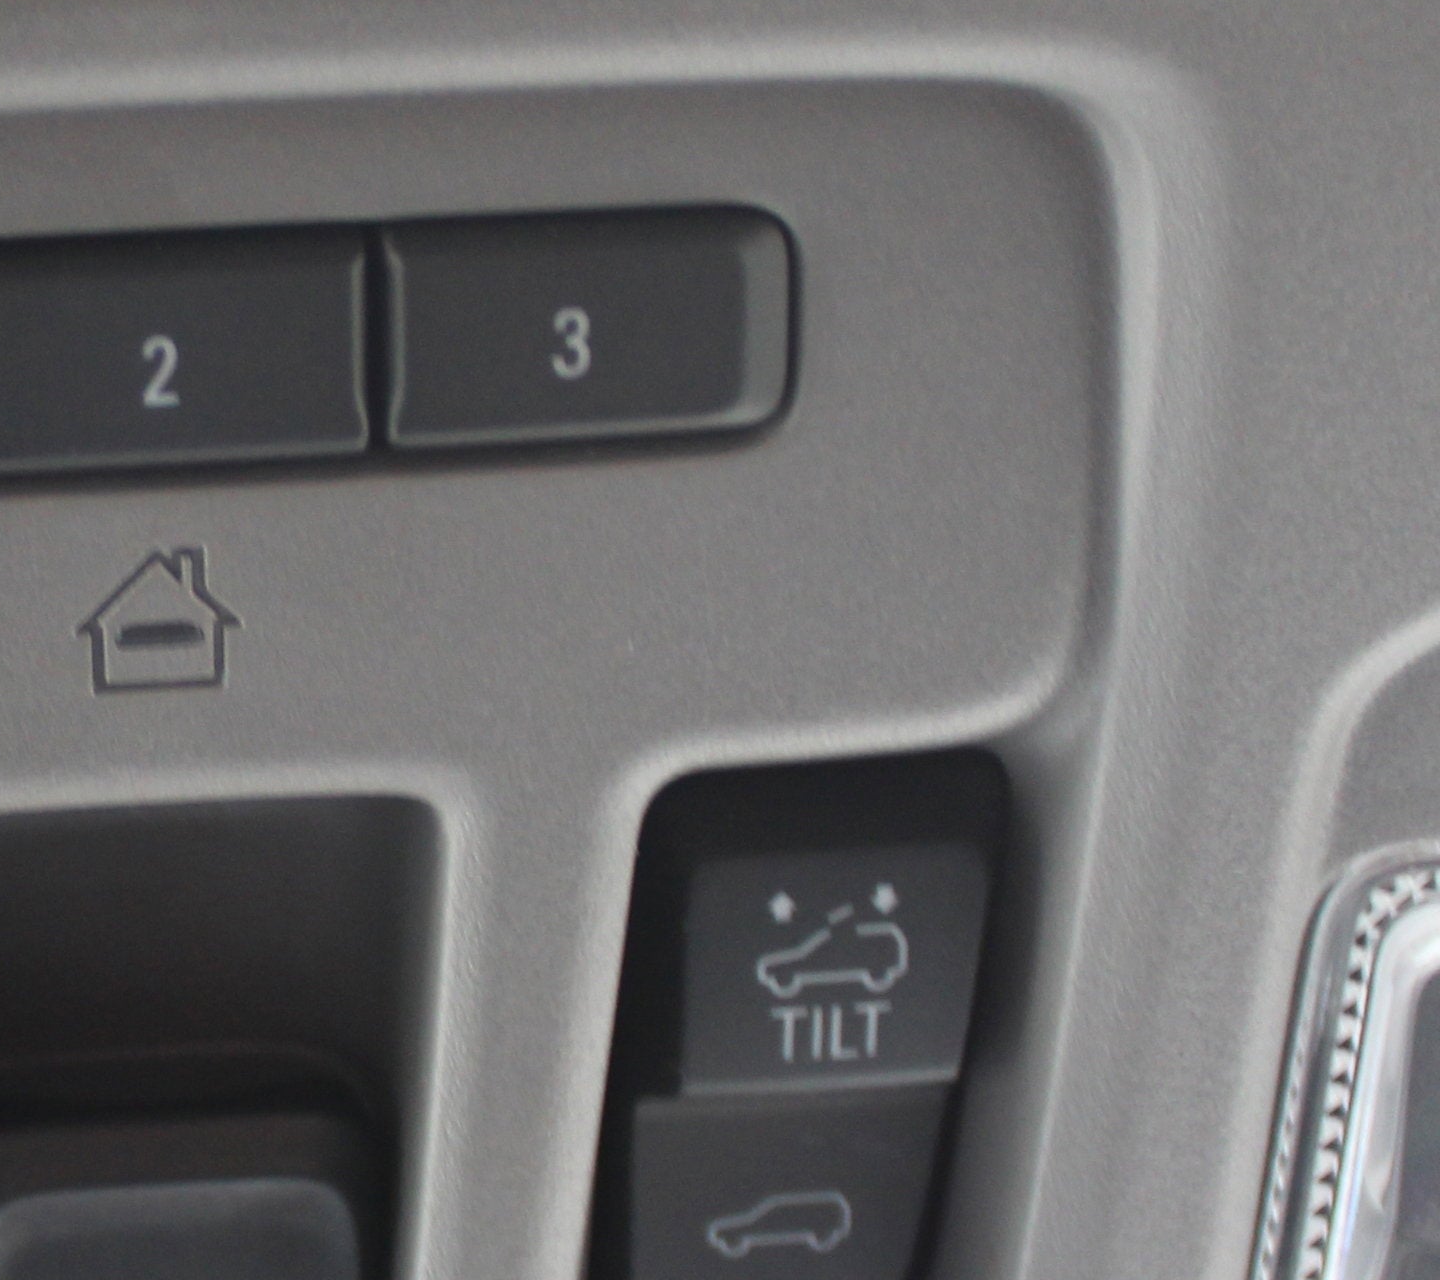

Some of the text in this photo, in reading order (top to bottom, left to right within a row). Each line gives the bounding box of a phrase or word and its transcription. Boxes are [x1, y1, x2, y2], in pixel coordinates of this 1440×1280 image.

[140, 334, 180, 410] 2
[552, 308, 594, 379] 3
[771, 1000, 892, 1063] TILT
